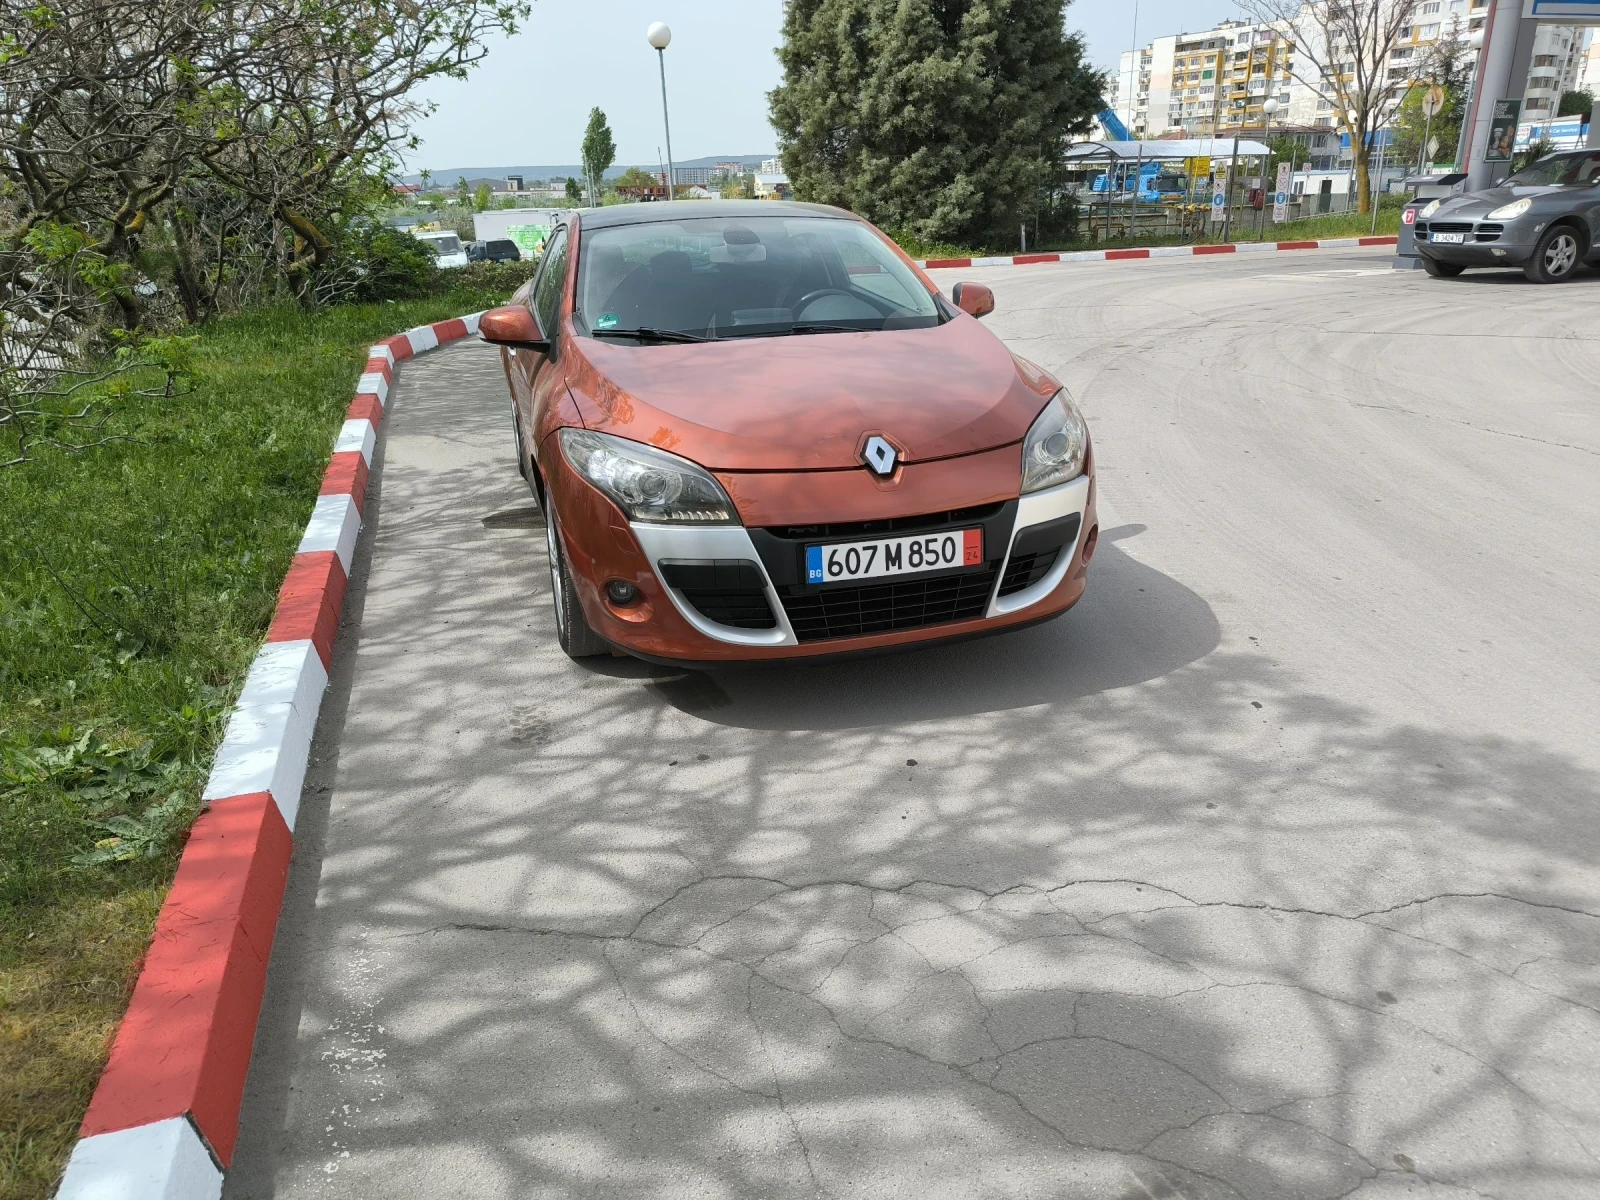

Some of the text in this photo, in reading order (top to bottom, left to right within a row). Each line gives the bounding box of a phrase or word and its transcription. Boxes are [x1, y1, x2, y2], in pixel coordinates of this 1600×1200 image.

[1406, 213, 1412, 221] 7
[827, 536, 956, 577] 607 M 850
[966, 551, 978, 561] 24
[809, 569, 822, 579] BG
